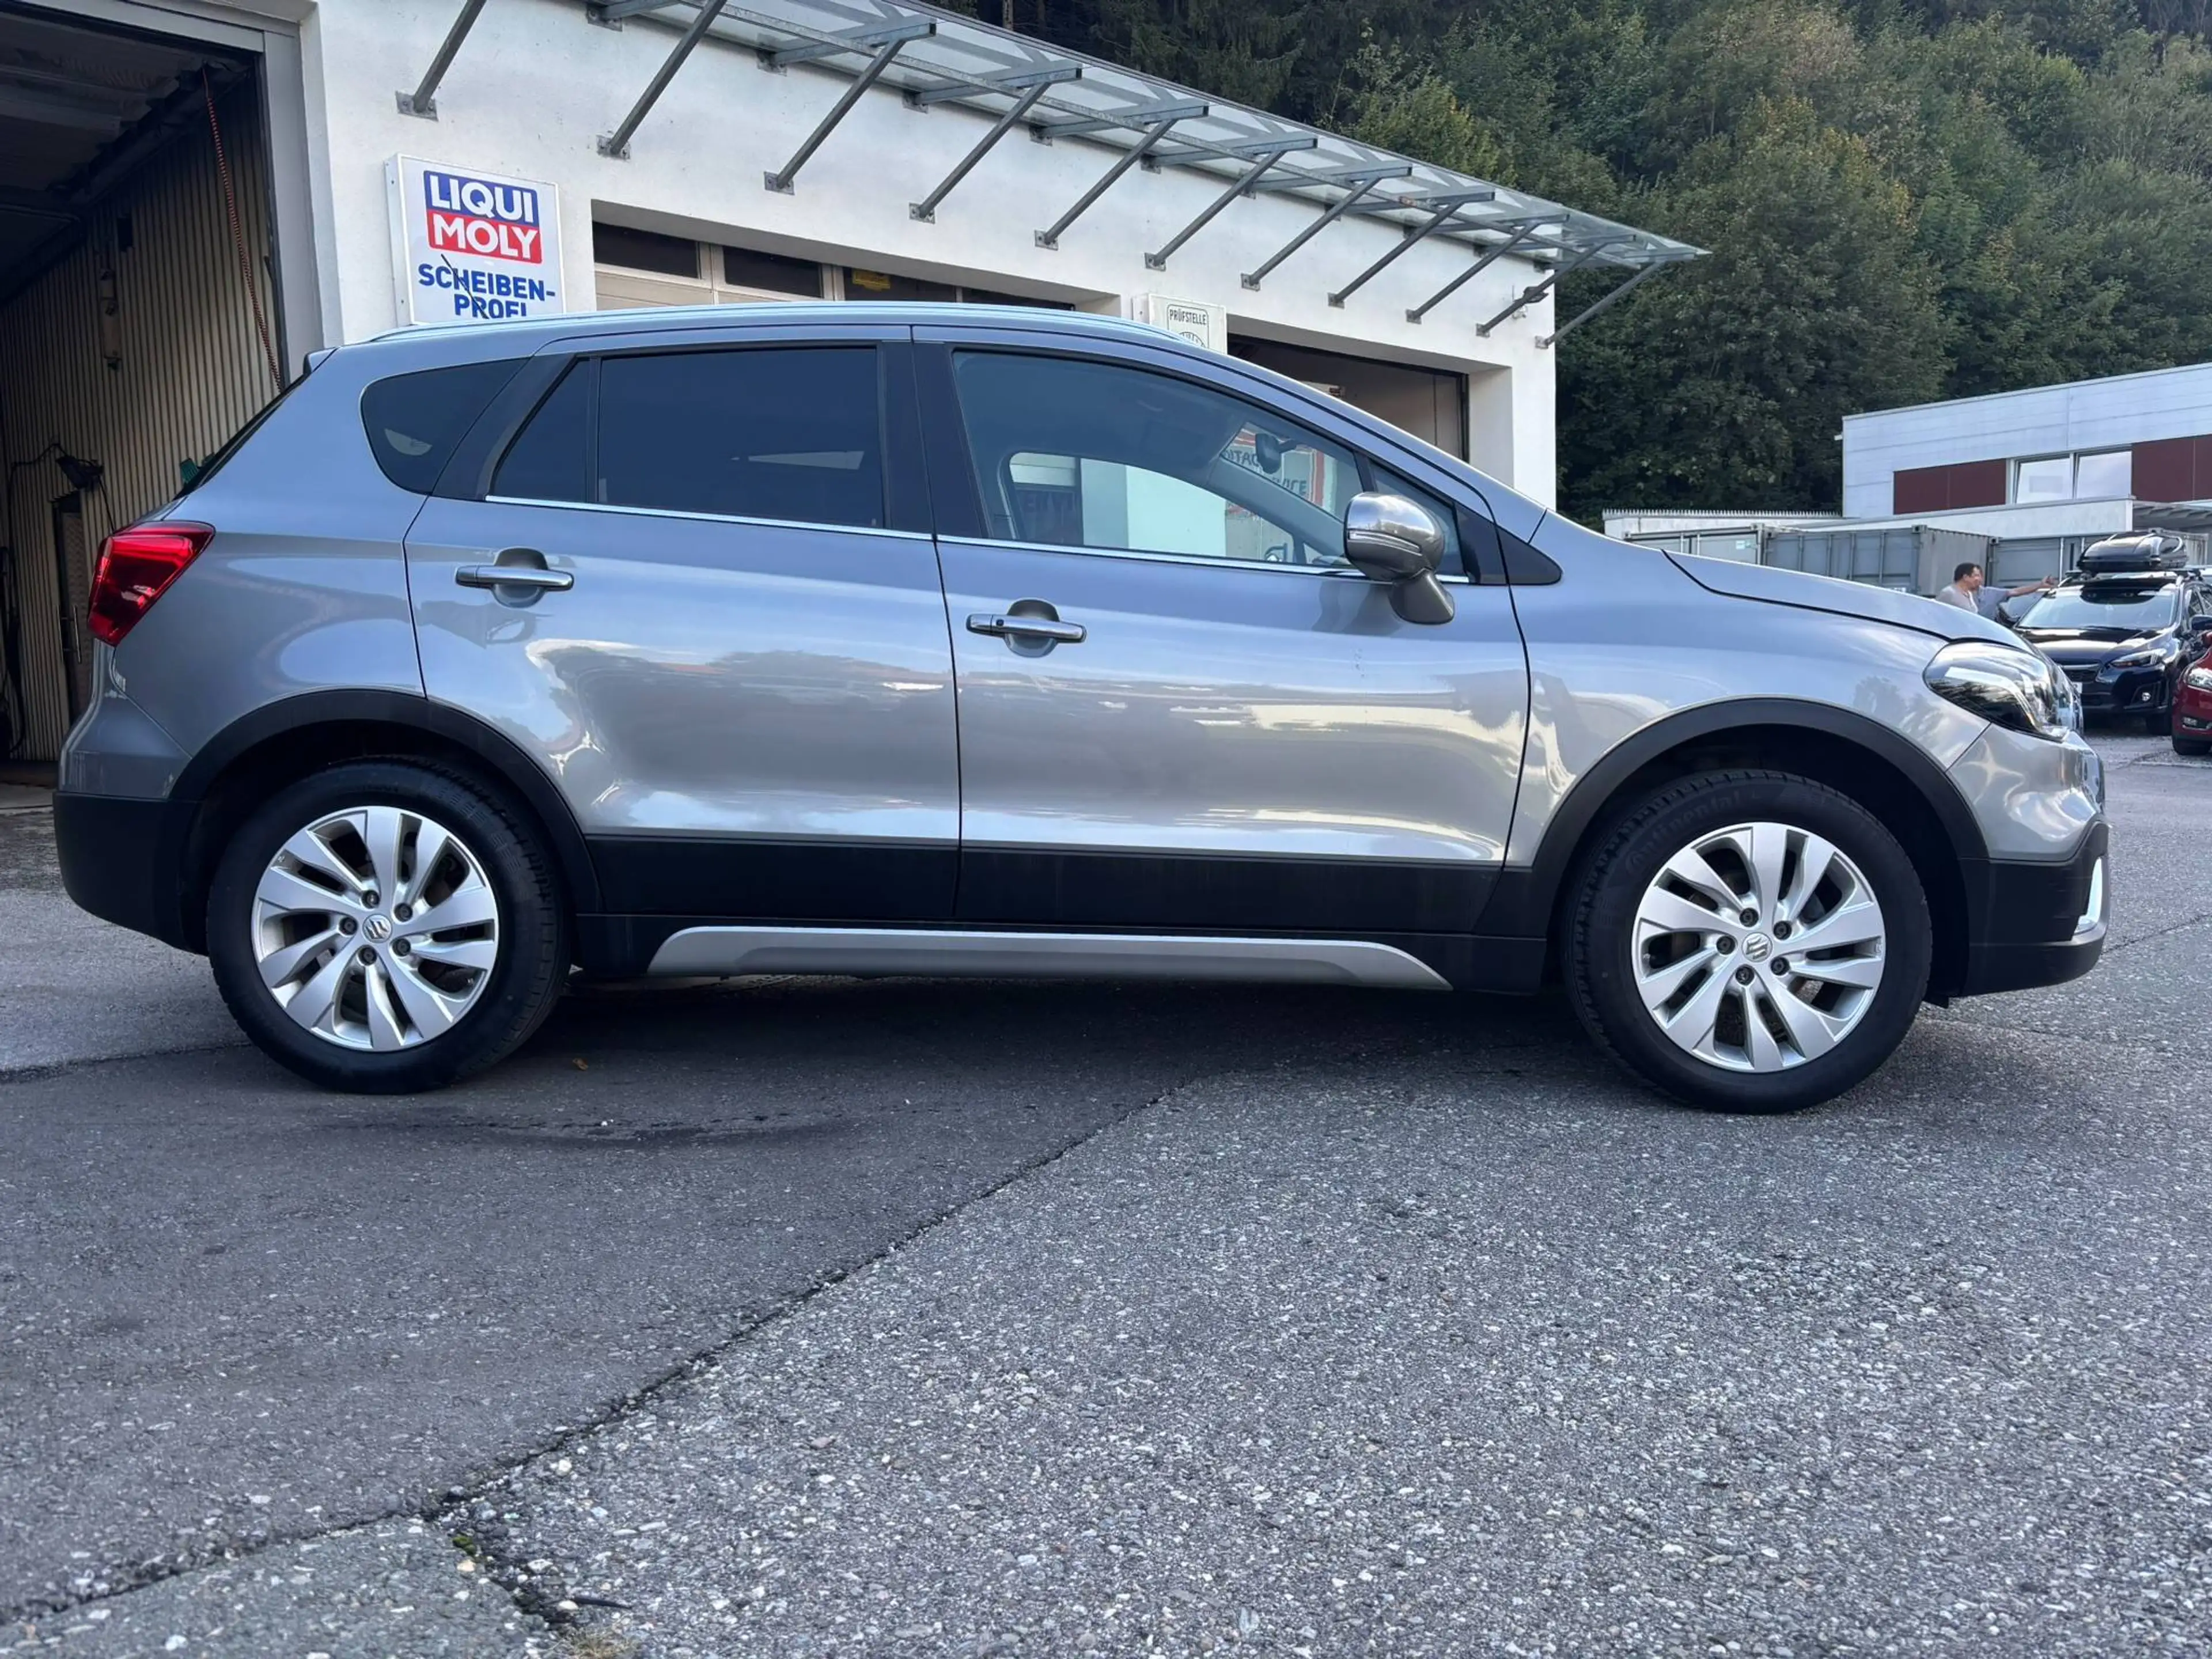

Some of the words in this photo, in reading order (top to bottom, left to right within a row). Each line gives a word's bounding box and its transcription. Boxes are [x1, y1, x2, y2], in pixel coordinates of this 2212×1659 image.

[430, 175, 533, 223] LIQUI
[433, 213, 538, 259] MOLY
[418, 263, 555, 301] SCHEIBEN-
[1169, 308, 1206, 325] PRÜFSTELLE
